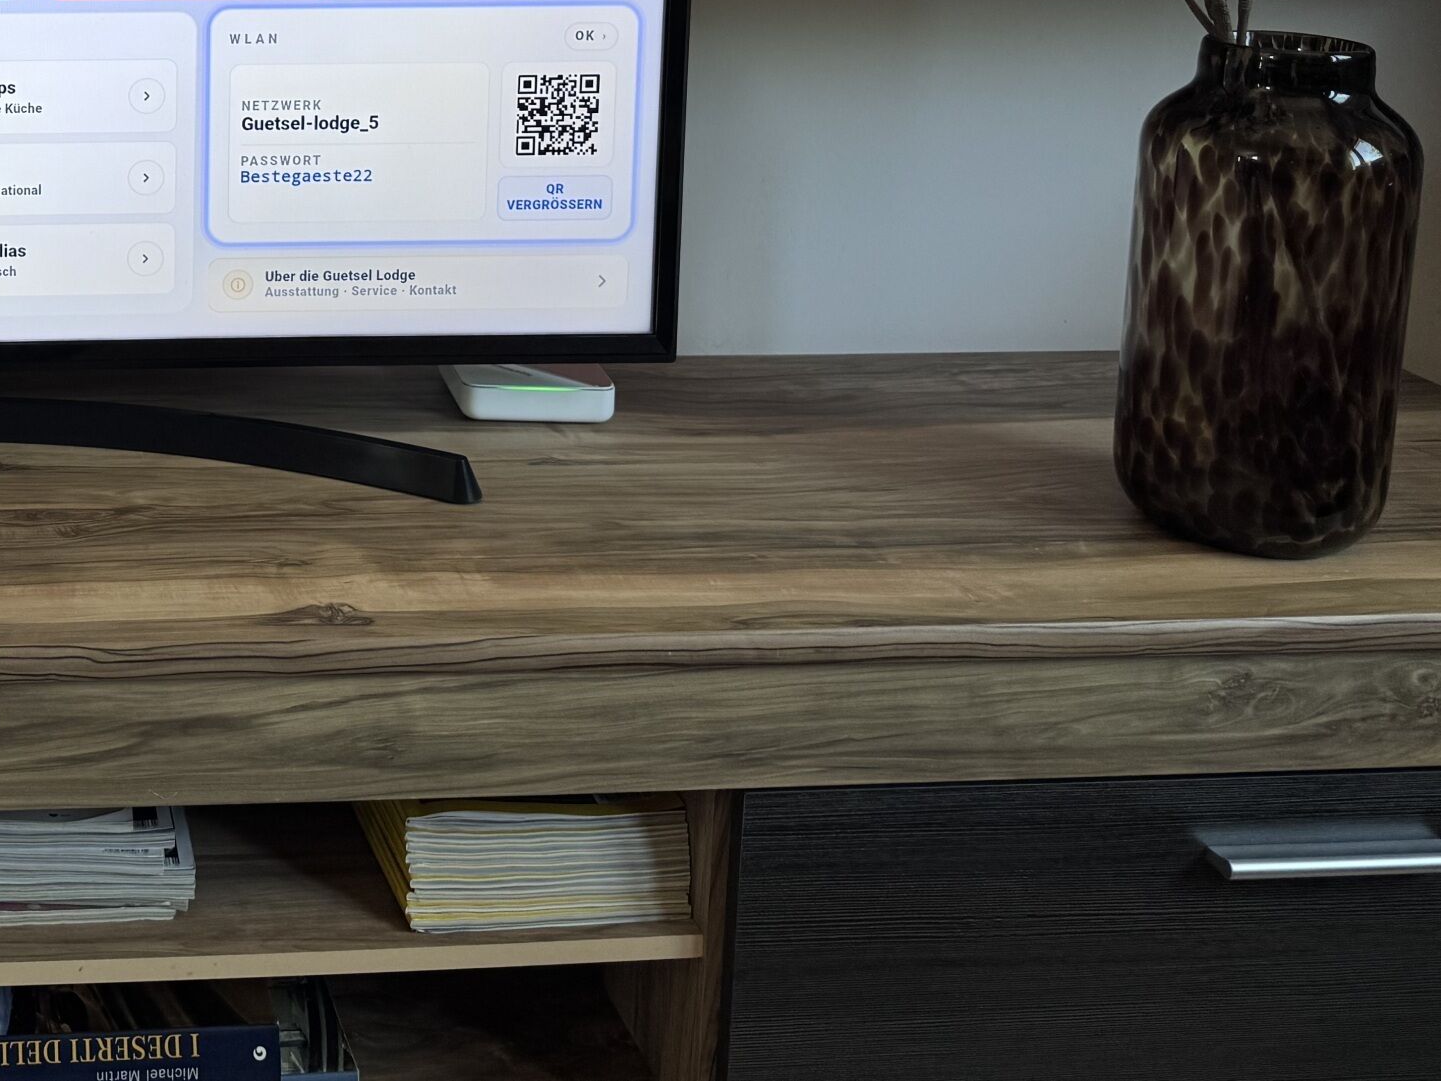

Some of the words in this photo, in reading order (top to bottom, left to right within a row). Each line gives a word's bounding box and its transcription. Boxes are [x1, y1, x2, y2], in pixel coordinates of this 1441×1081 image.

[229, 33, 278, 45] WLAN
[575, 30, 595, 41] OK
[5, 101, 42, 114] Küche
[242, 99, 322, 112] NETZWERK
[241, 115, 379, 133] Guetsel-lodge_5
[241, 154, 322, 167] PASSWORT
[240, 170, 373, 186] Bestegaeste22
[546, 183, 564, 196] QR
[507, 196, 603, 212] VERGRÖSSERN
[298, 269, 319, 283] die
[322, 269, 372, 282] Guetsel
[376, 269, 416, 284] Lodge
[265, 286, 339, 299] Ausstattung
[352, 285, 398, 297] Service
[409, 284, 457, 296] Kontakt
[69, 1035, 184, 1064] DESERTI
[97, 1069, 141, 1080] Martin
[146, 1067, 199, 1080] Michael
